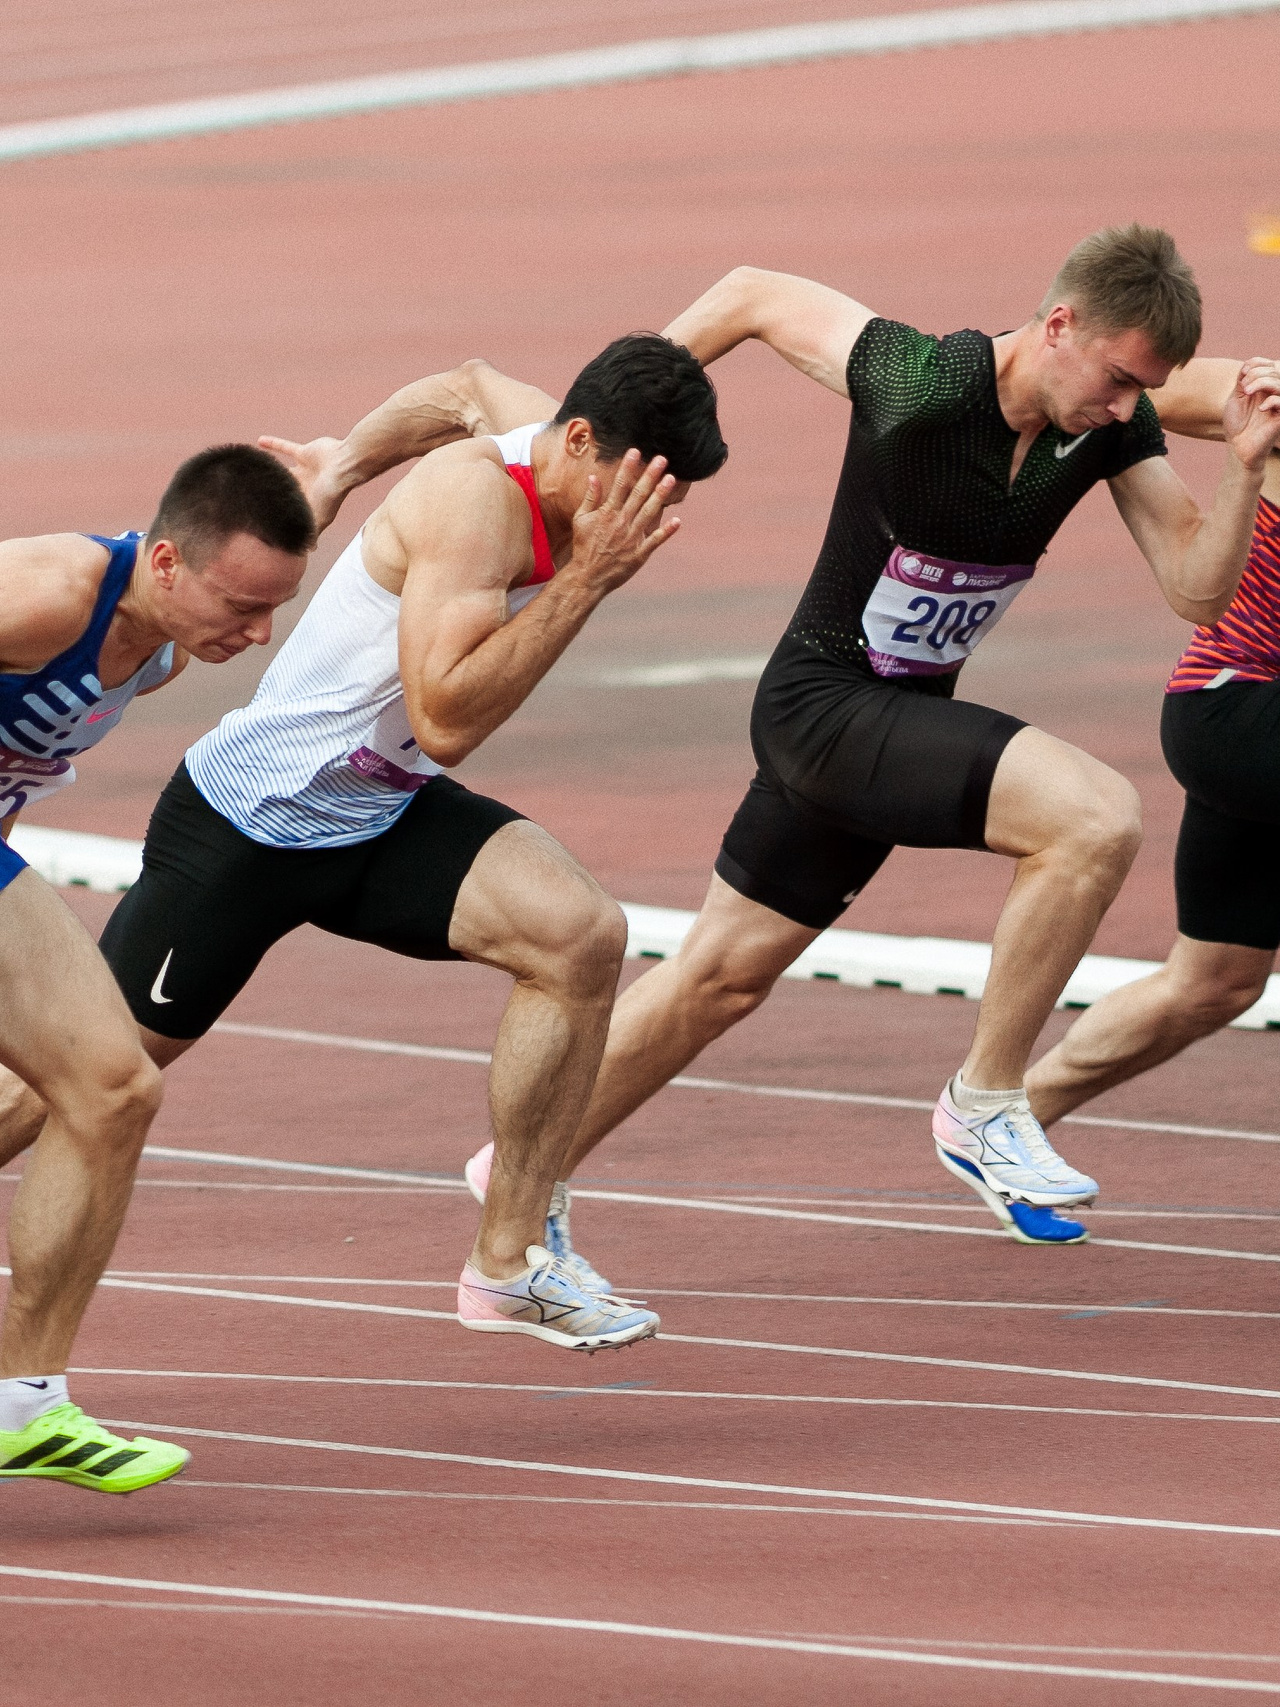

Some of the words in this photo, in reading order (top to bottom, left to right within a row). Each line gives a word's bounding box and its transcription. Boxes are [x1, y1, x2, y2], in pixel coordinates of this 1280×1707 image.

[922, 564, 944, 578] НГК
[966, 579, 1005, 587] ЛИЗИНГ
[891, 595, 996, 650] 208
